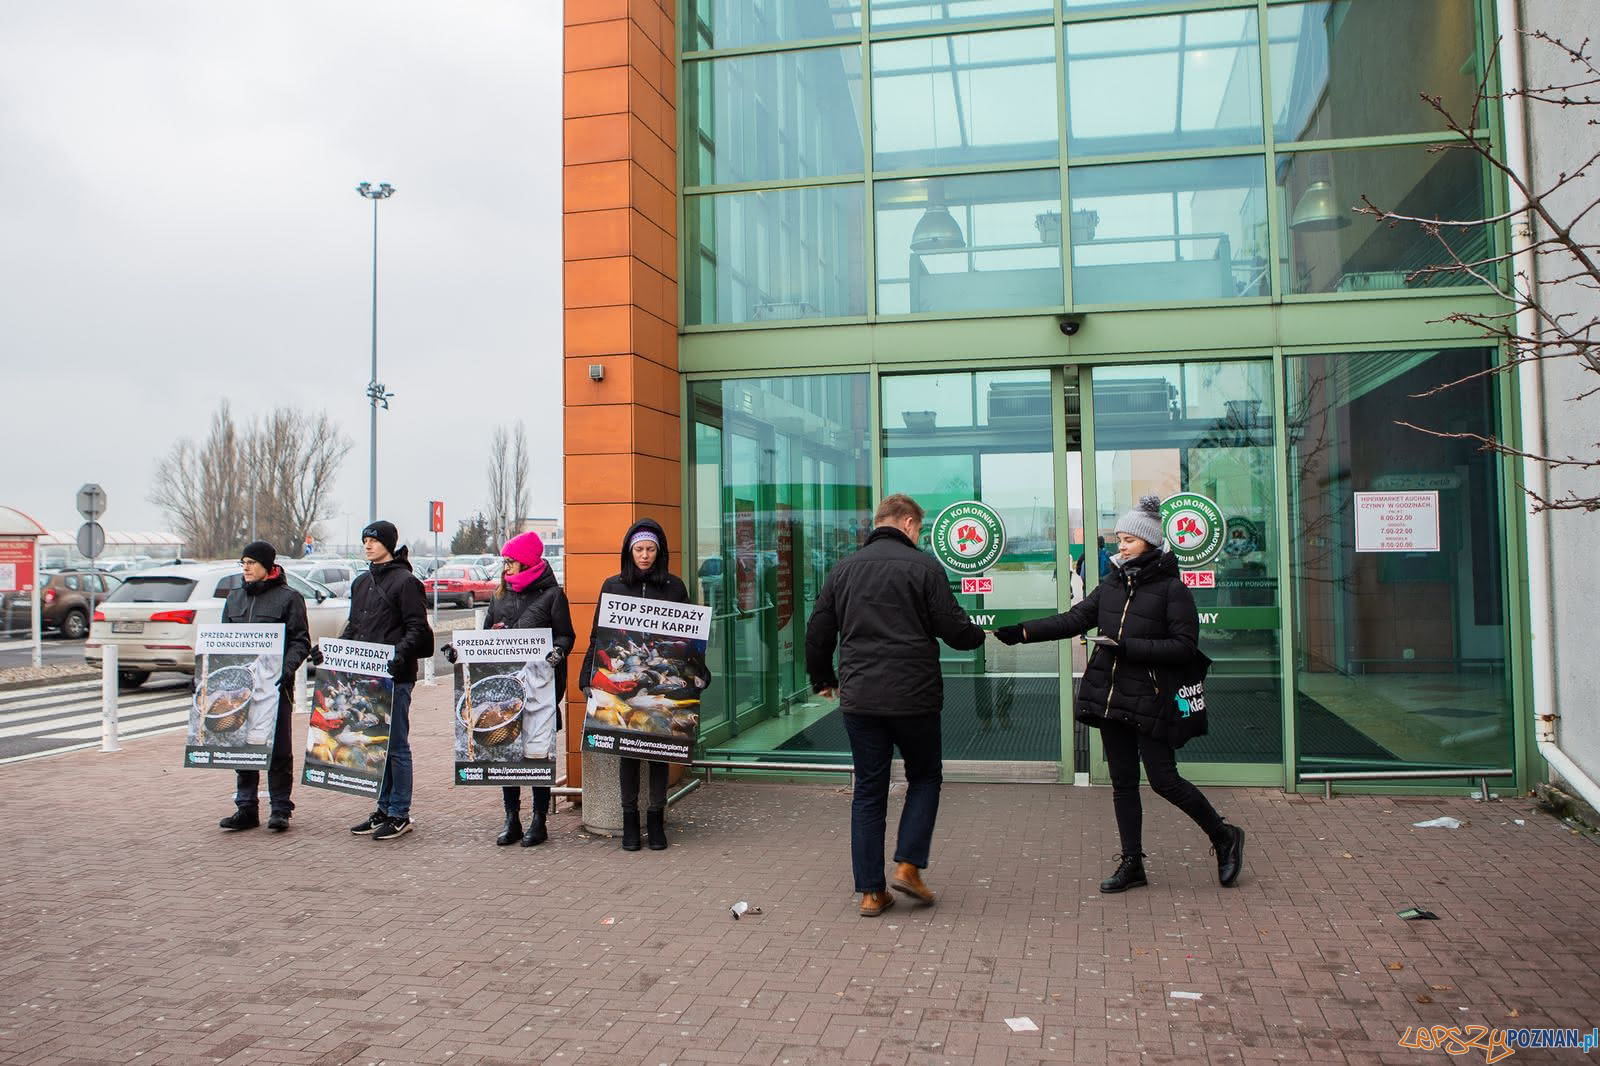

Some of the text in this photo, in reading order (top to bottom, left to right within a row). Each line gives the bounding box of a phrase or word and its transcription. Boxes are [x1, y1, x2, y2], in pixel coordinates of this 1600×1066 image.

[1170, 498, 1217, 522] KOMORNIKI
[938, 507, 996, 552] AUCHAN KOMORNIKI
[946, 533, 1000, 569] CENTRUM HANDLOWE
[1196, 527, 1221, 560] HANDLOWE
[607, 600, 704, 621] STOP SPRZEDAŻY
[609, 612, 699, 634] ŻYWYCH KARPI!
[323, 643, 390, 660] STOP SPRZEDAŻY
[456, 637, 546, 646] SPRZEDAŻ ŻYWYCH RYB
[477, 646, 541, 656] OKRUCIEŃSTWO!
[324, 654, 387, 673] ŻYWYCH KARPI!
